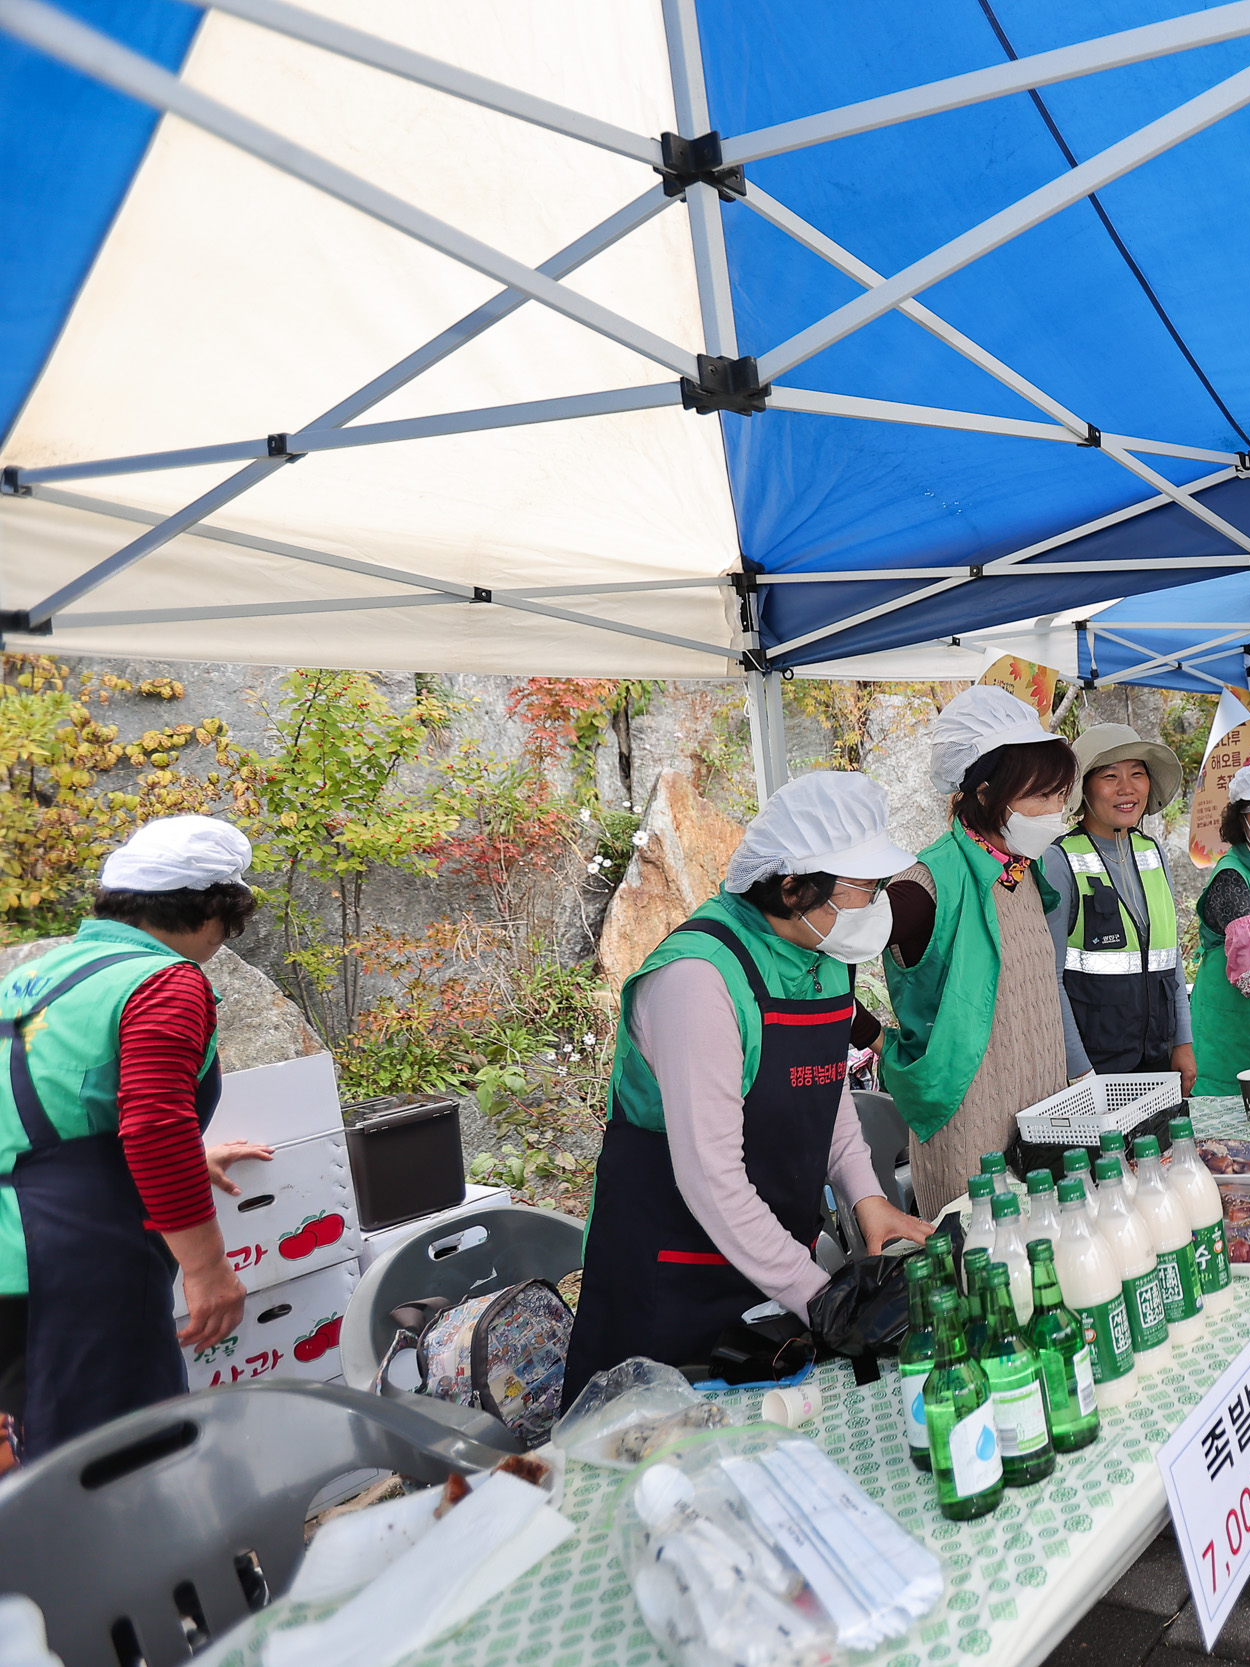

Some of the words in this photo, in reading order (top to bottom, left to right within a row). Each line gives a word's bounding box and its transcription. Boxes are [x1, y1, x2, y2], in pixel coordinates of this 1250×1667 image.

[1214, 731, 1241, 748] 나루
[1211, 751, 1241, 770] 해오름
[789, 1066, 812, 1087] 광장동
[209, 1349, 285, 1388] 사과
